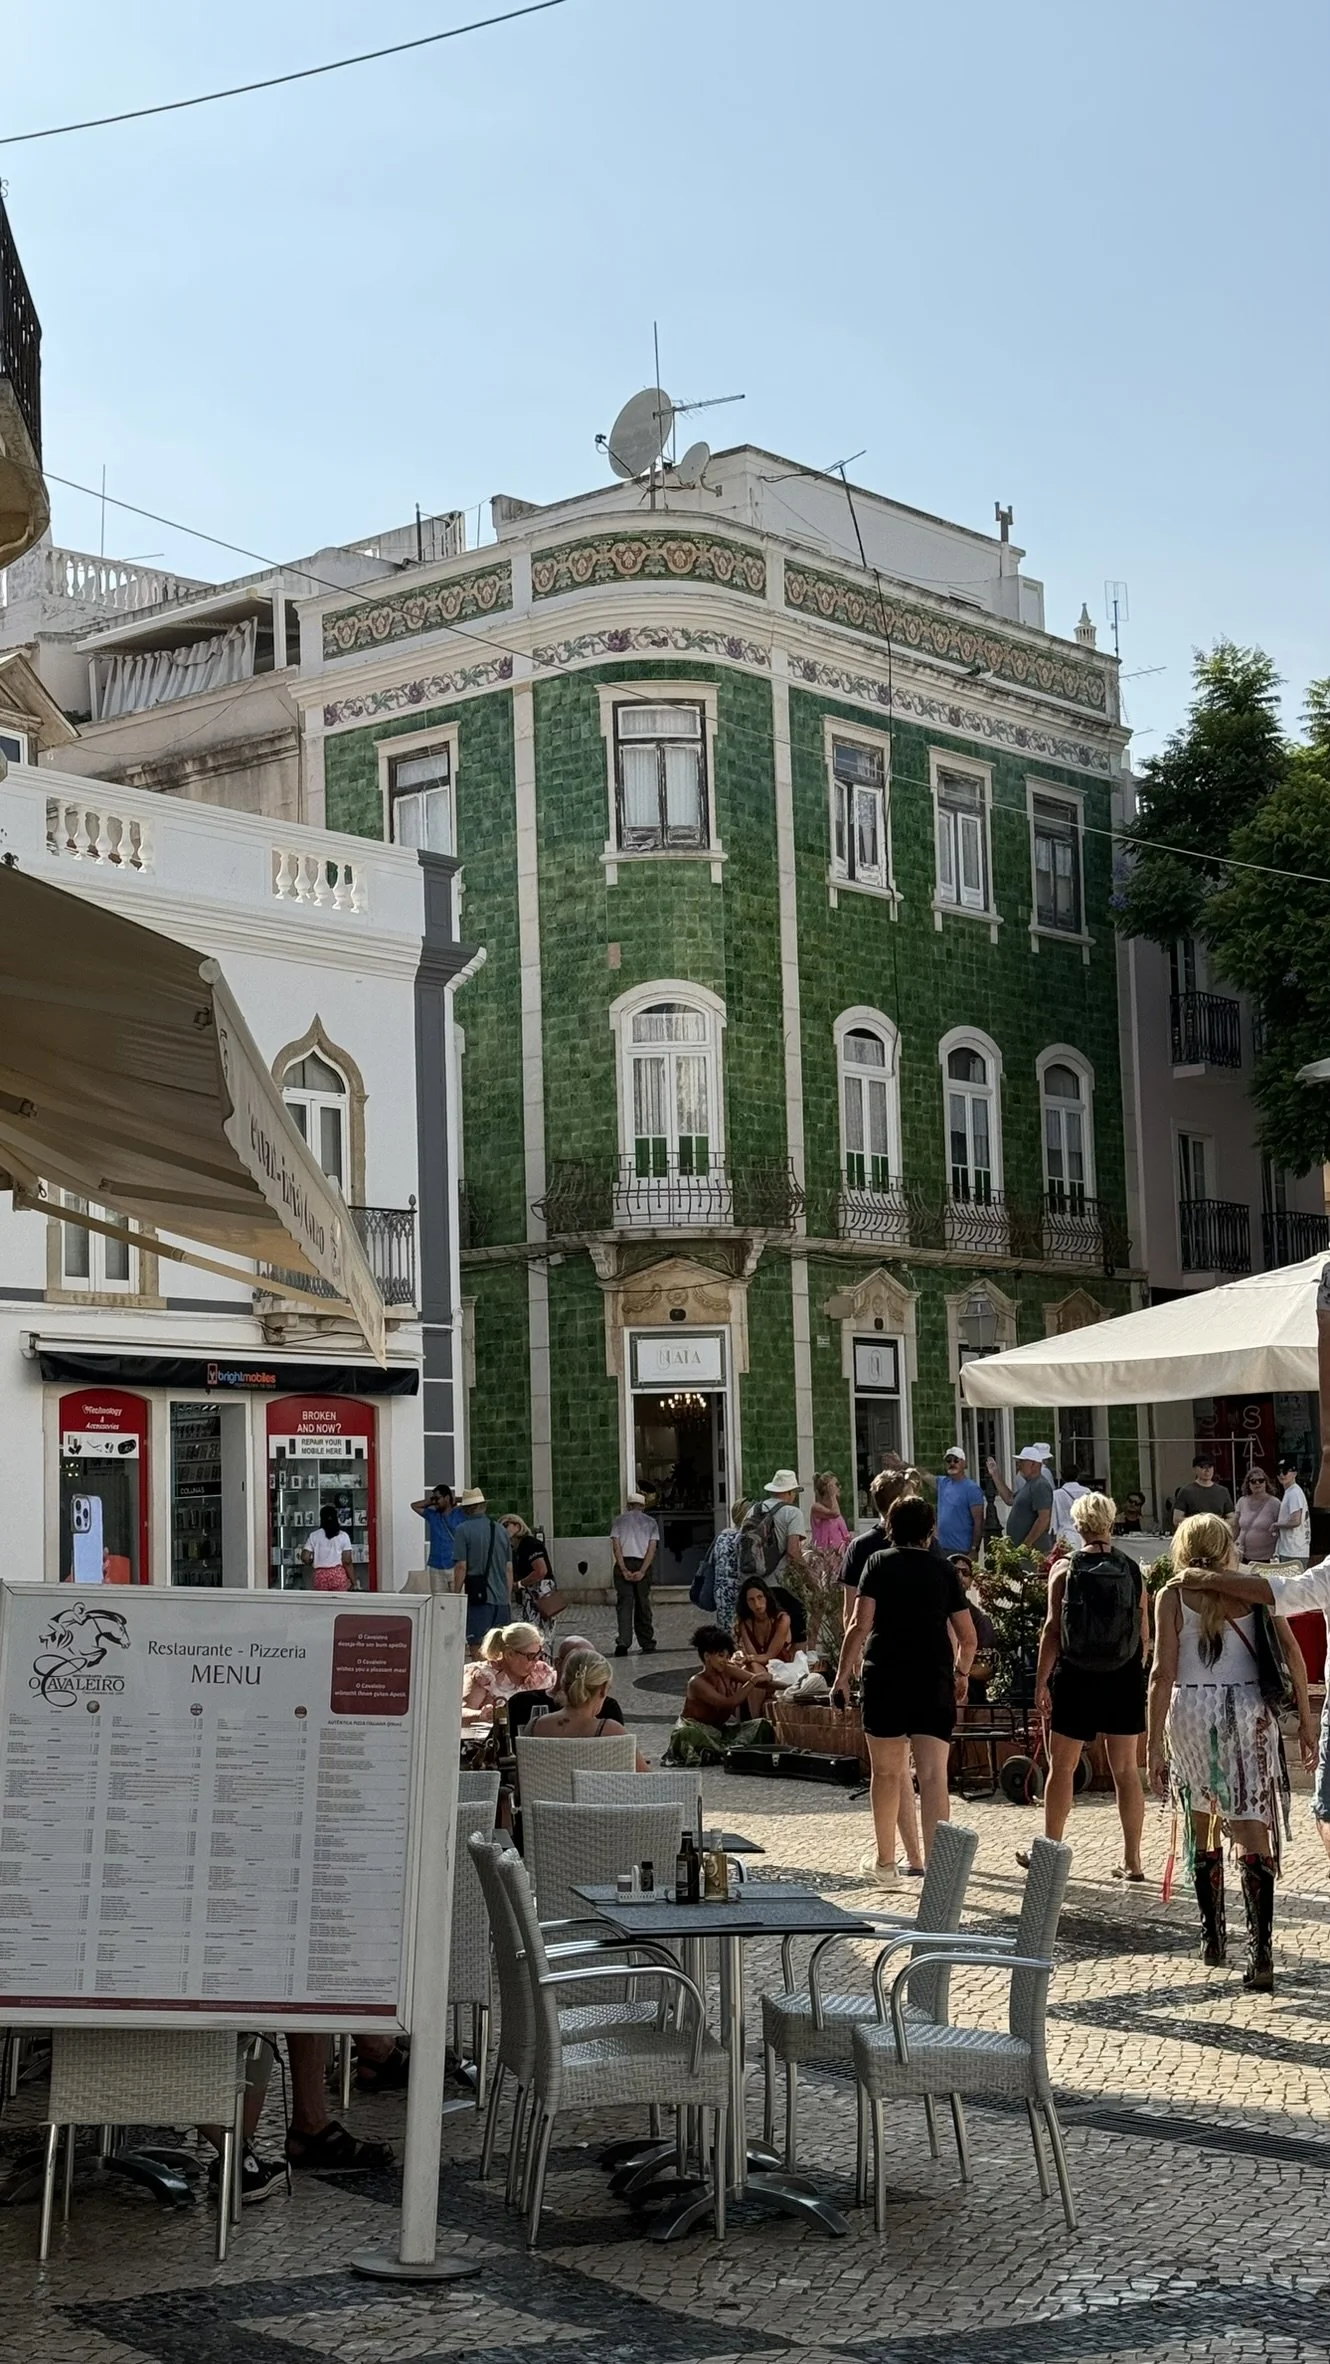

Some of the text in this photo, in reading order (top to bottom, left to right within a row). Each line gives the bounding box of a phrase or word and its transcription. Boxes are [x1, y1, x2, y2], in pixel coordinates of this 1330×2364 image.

[218, 1370, 277, 1384] brightmobiles
[82, 1404, 123, 1417] Technology
[302, 1410, 337, 1421] BROKEN
[86, 1422, 120, 1430] Accessories
[297, 1422, 342, 1434] AND NOW?
[301, 1438, 342, 1447] REPAIR YOUR
[301, 1447, 342, 1455] MOBILE HERE
[148, 1640, 233, 1657] Restaurante
[249, 1643, 306, 1659] Pizzeria
[191, 1664, 262, 1685] MENU
